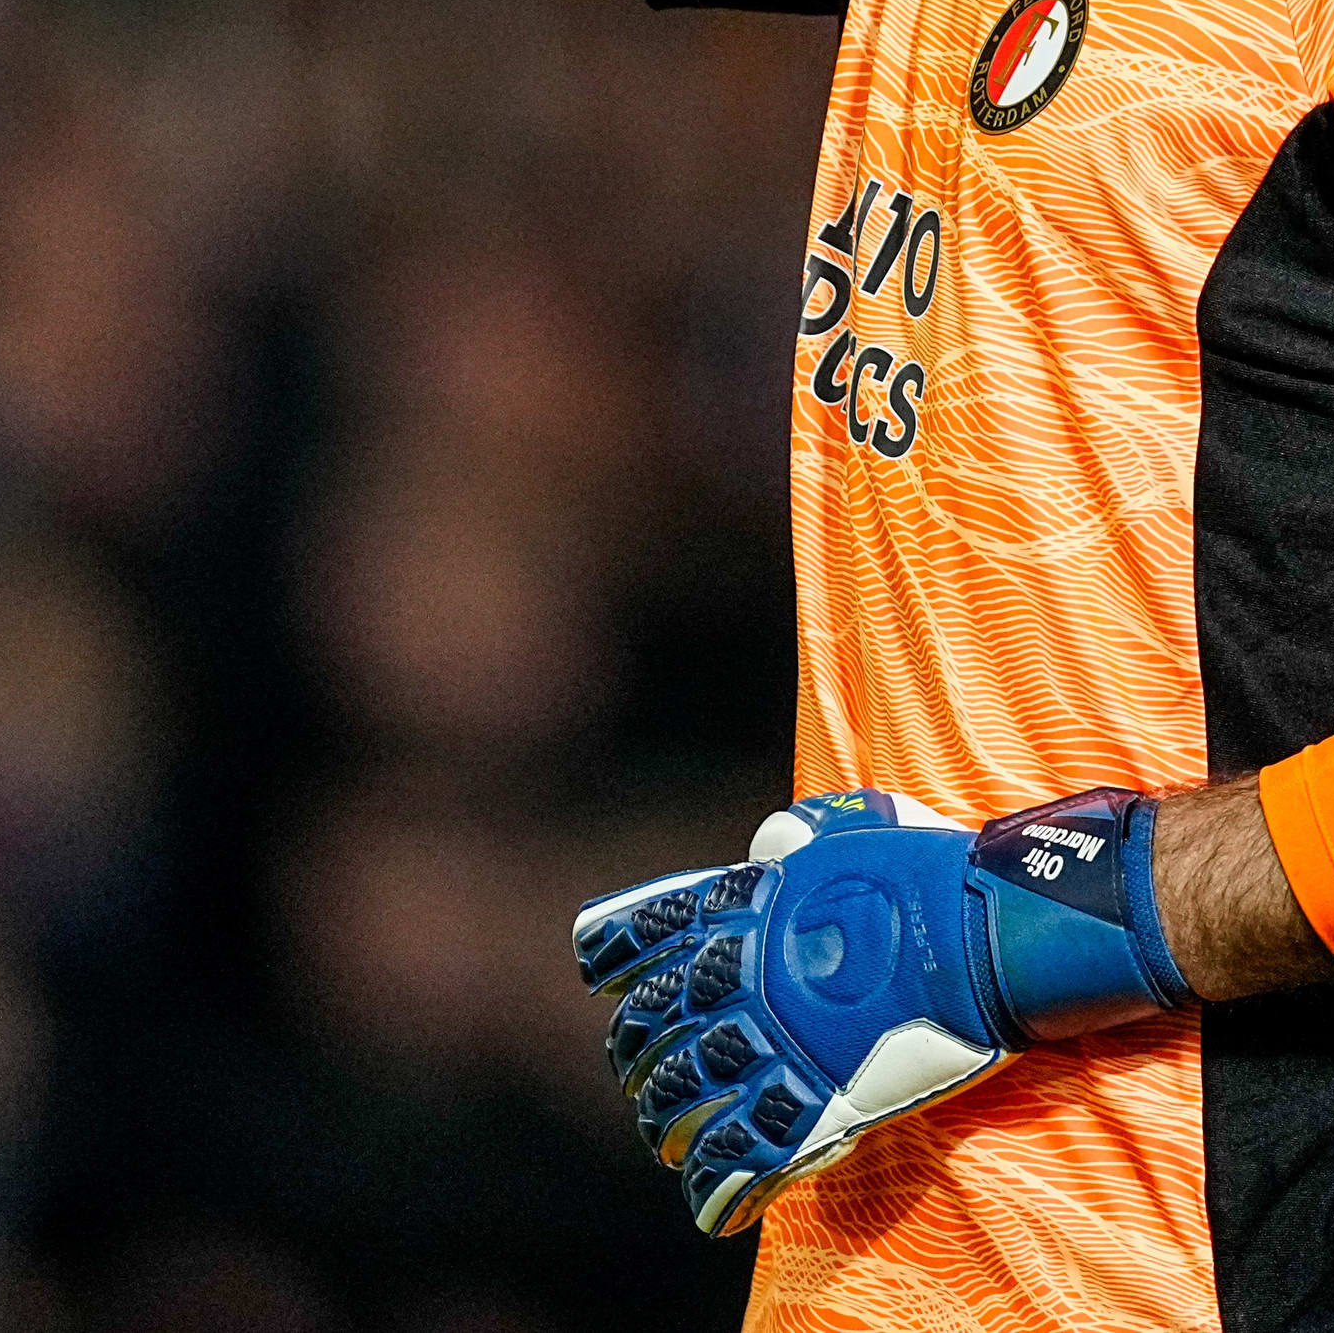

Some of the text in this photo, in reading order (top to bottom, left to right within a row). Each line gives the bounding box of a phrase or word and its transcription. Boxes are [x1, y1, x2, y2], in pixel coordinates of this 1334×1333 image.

[972, 60, 1048, 127] ROTTERDAM
[1021, 824, 1106, 863] Marciano
[1021, 847, 1064, 881] Ofir
